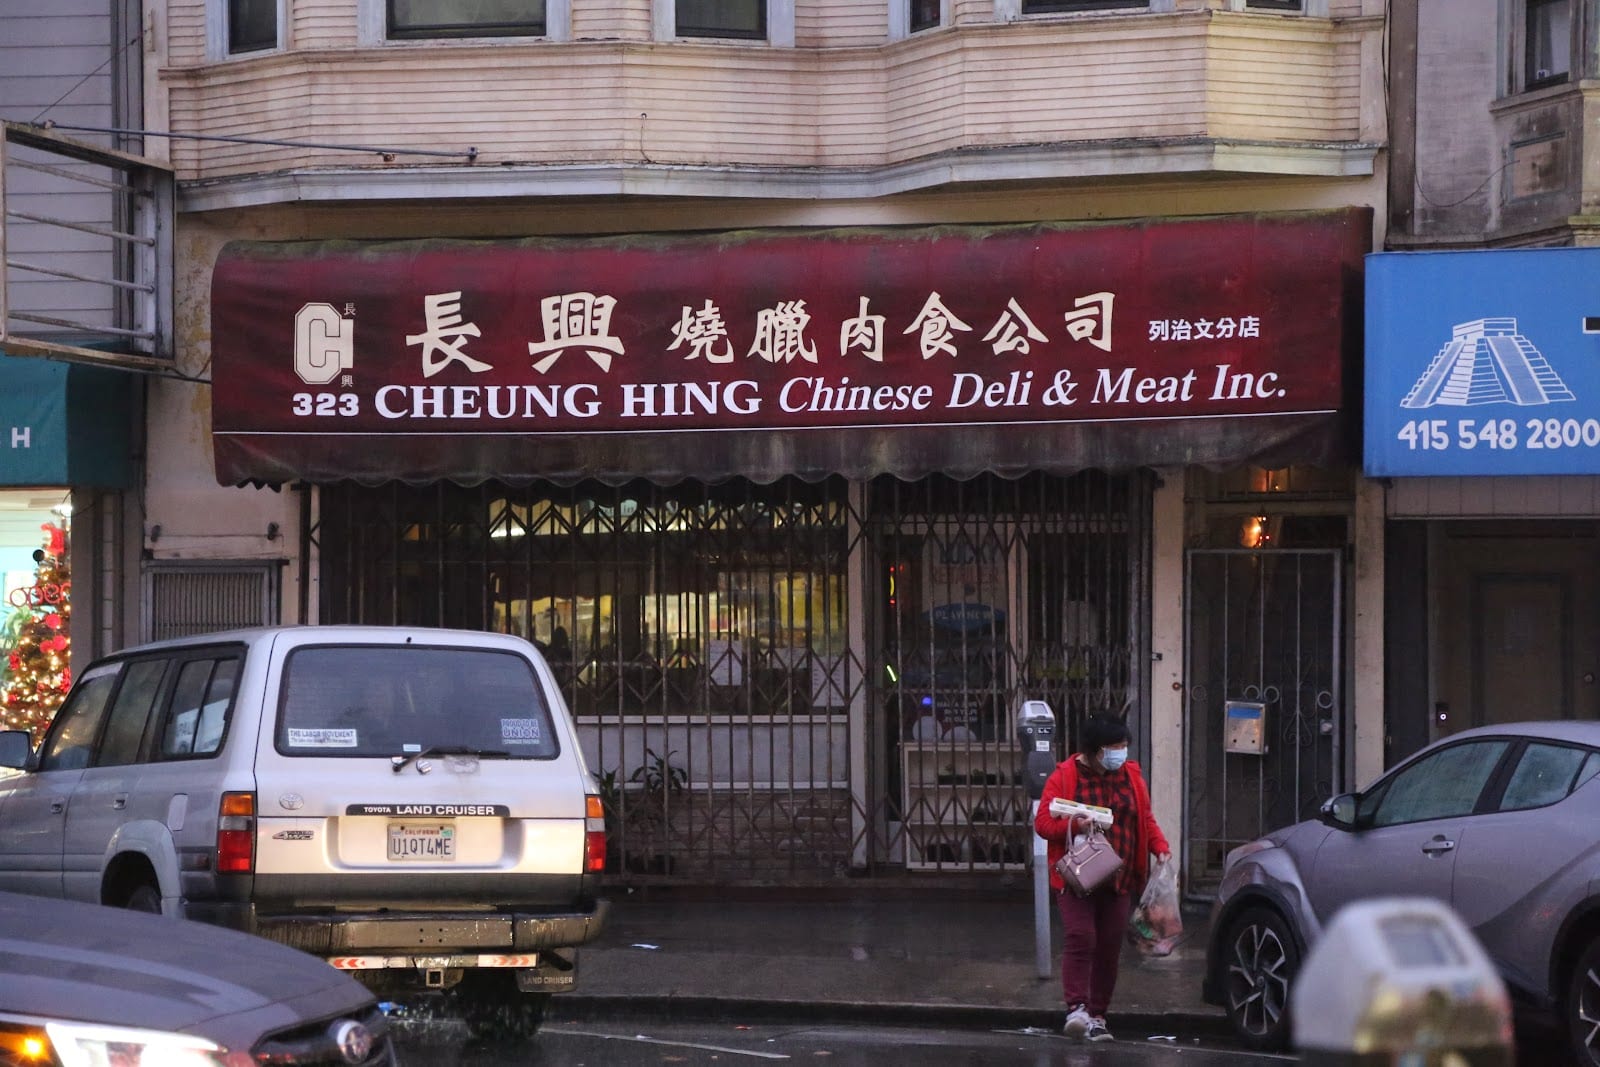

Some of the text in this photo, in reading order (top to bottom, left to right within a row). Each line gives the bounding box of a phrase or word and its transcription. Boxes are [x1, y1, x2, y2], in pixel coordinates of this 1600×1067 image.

[1149, 316, 1260, 341] 列治文分店
[375, 364, 1286, 418] CHEUNG HING Chinese Deli & Meat Inc.
[293, 393, 360, 416] 323
[11, 427, 31, 448] H
[1398, 418, 1600, 450] 415 548 2800
[502, 727, 540, 738] UNION
[363, 805, 495, 816] TOYOTA LAND CRUISER
[392, 837, 452, 855] U1QT4ME
[543, 976, 574, 985] CRUISER
